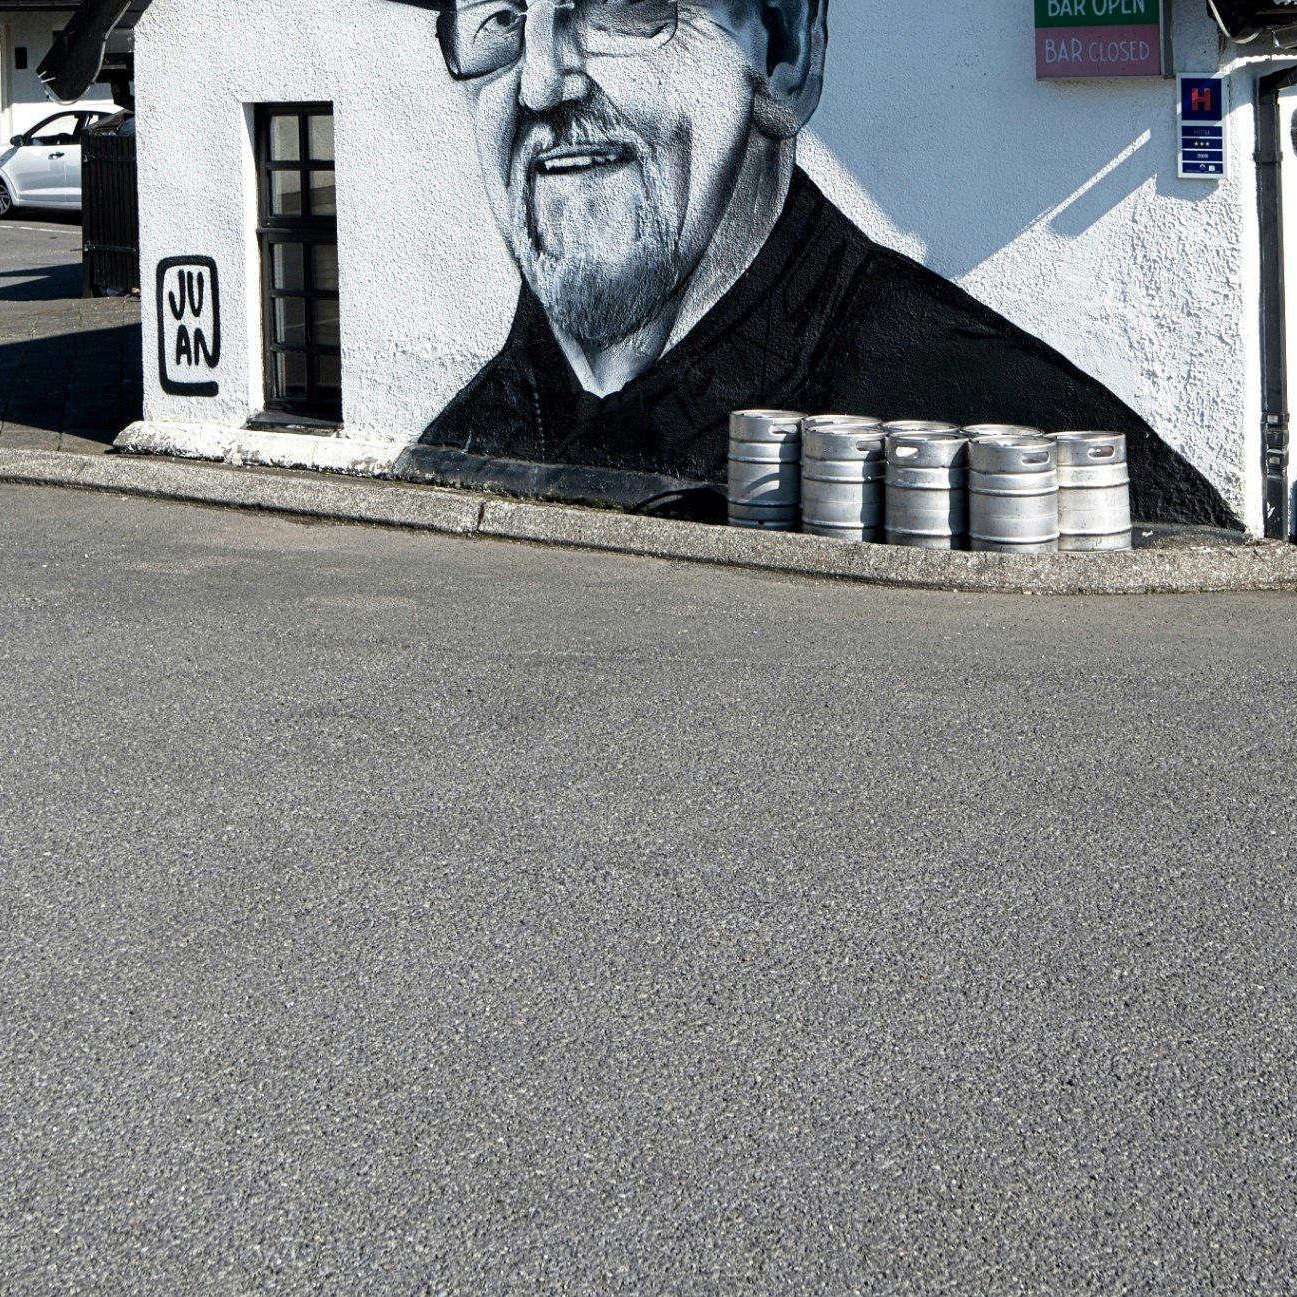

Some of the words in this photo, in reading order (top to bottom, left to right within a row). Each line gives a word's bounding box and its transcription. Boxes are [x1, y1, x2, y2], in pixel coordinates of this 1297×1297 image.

[1045, 38, 1083, 64] BAR
[1088, 40, 1151, 63] CLOSED
[1191, 87, 1212, 112] H
